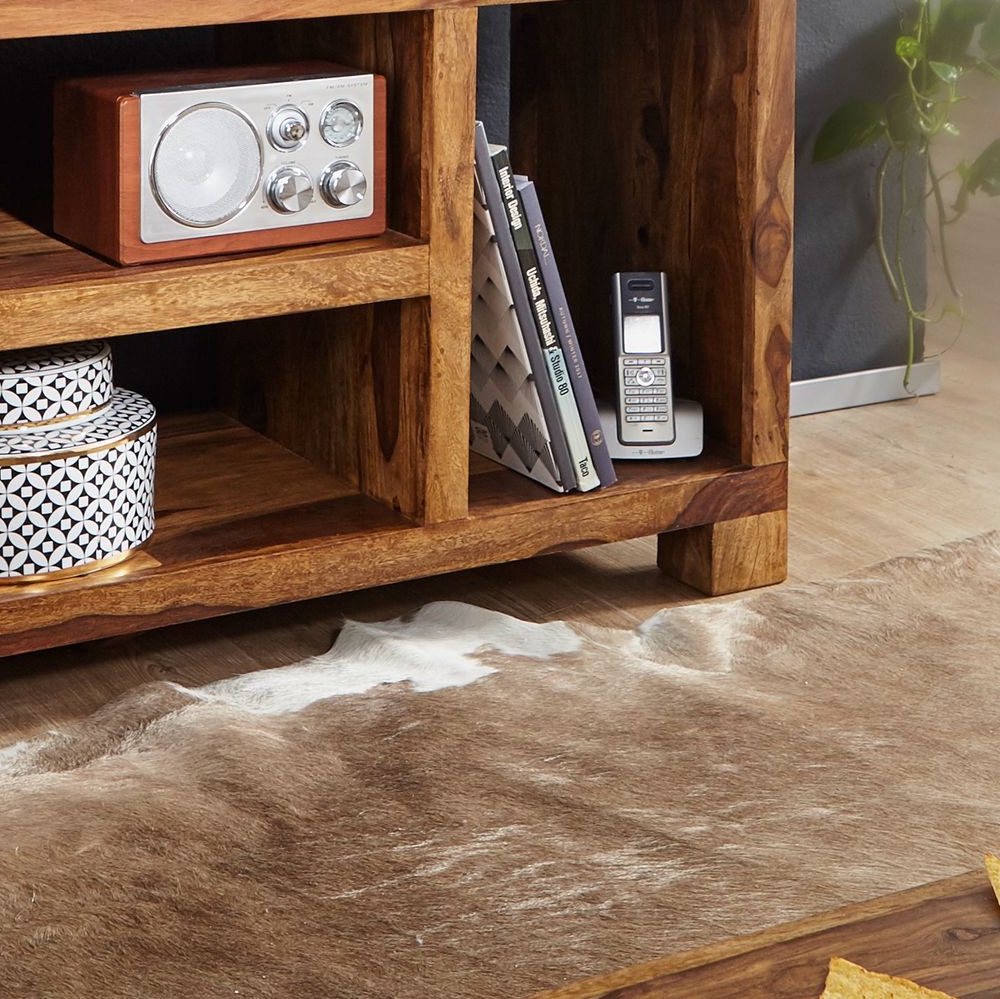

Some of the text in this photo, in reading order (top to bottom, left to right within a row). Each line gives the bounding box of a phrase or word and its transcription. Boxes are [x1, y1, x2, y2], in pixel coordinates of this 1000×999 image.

[498, 165, 523, 231] Interior Design
[526, 266, 542, 301] Uchida,
[550, 353, 565, 383] Studio
[558, 382, 570, 397] 80
[578, 455, 590, 478] Taco
